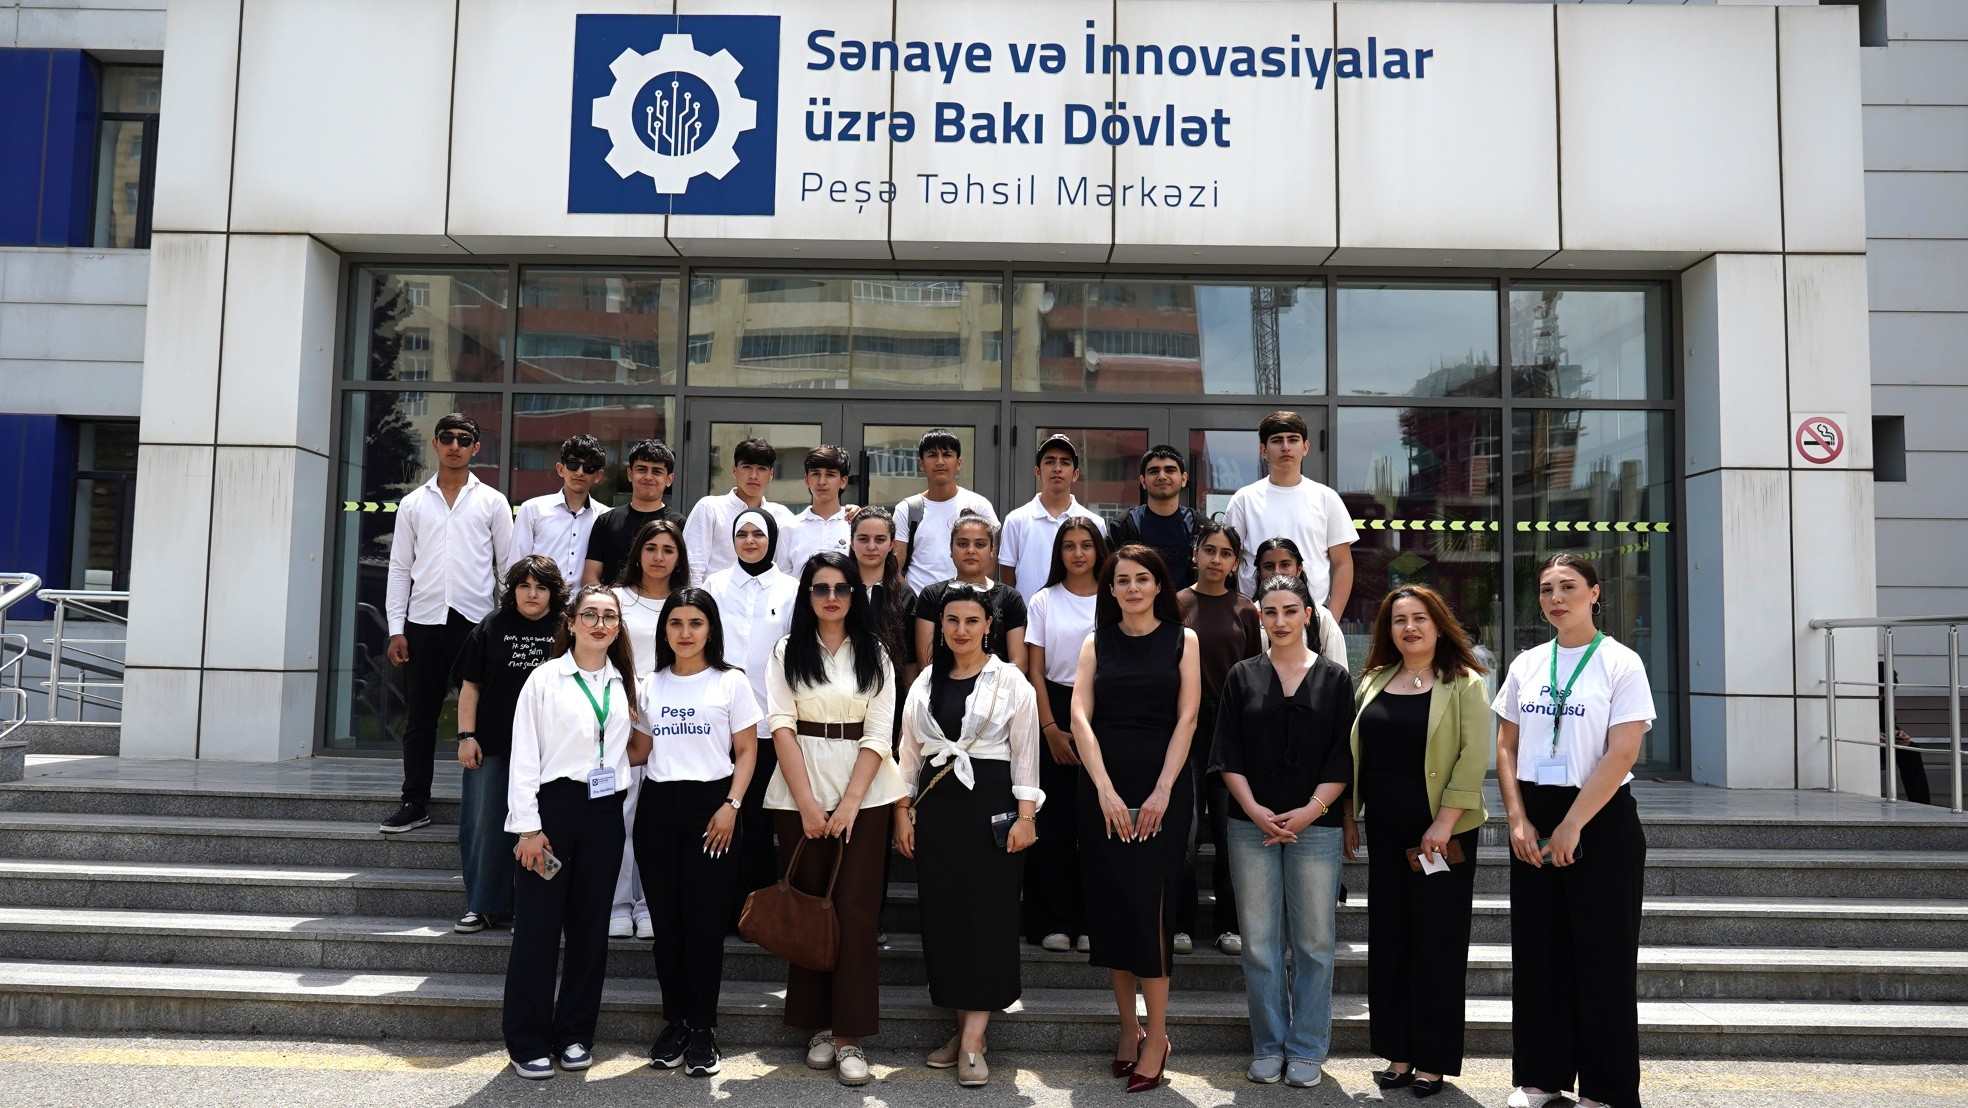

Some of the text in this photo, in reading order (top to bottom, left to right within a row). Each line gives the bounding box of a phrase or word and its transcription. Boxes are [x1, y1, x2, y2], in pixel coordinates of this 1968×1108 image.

[806, 19, 1434, 90] Sənaye və İnnovasiyalar
[804, 97, 1231, 148] üzrə Bakı Dövlət
[801, 172, 1219, 213] Peşə Təhsil Mərkəzi
[652, 722, 711, 736] önüllüsü
[661, 706, 696, 721] Peşə
